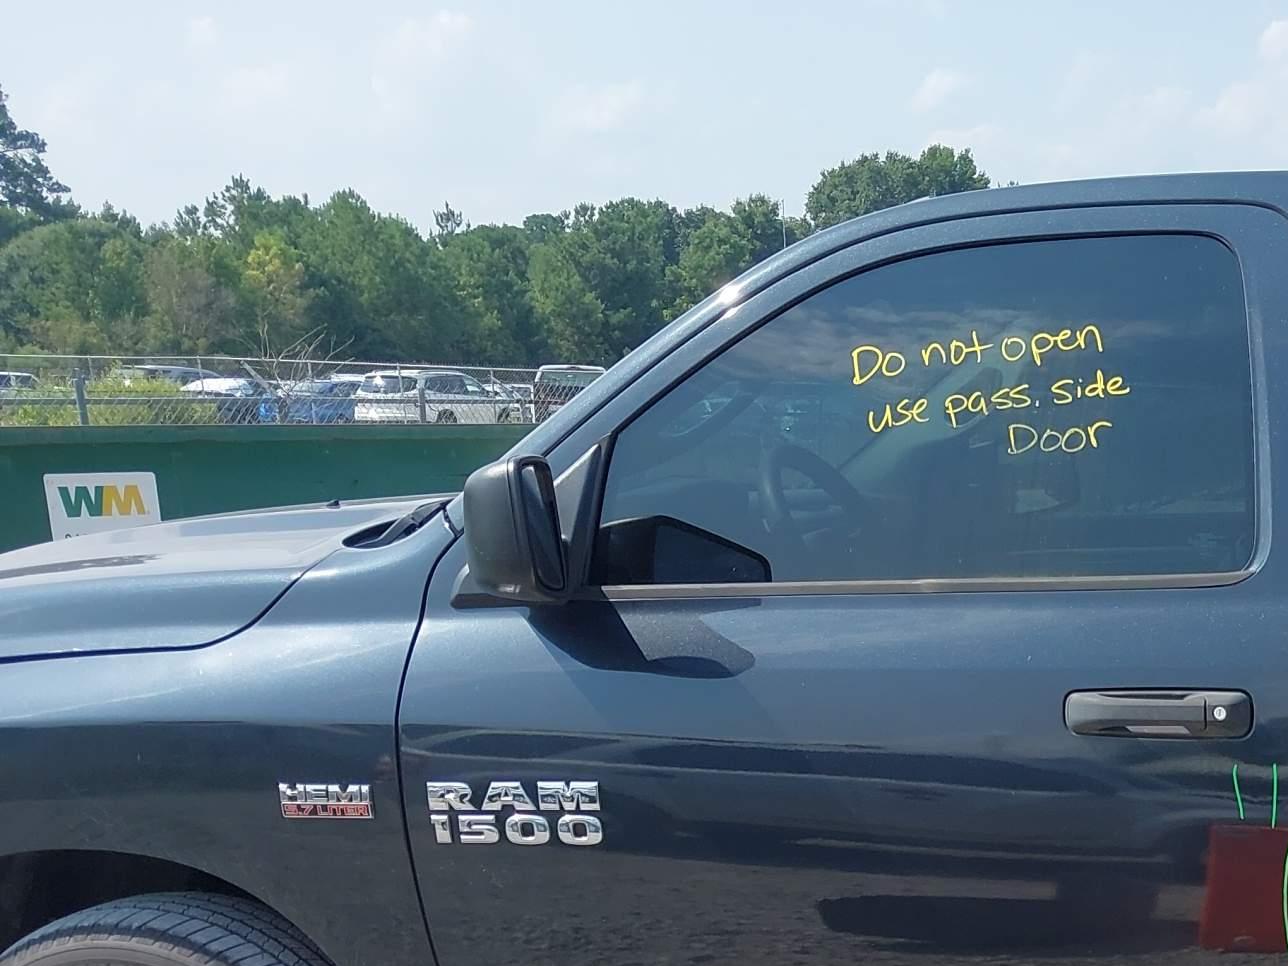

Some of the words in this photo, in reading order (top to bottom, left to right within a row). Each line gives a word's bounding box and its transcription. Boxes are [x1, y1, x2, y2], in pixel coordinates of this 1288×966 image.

[851, 345, 905, 385] Do
[921, 330, 994, 365] not
[1001, 324, 1104, 366] open
[868, 395, 930, 433] use
[944, 383, 1040, 428] pass.
[1051, 369, 1131, 405] side
[1007, 420, 1113, 455] Door
[57, 484, 146, 518] WM
[279, 782, 371, 803] HEMI
[426, 780, 601, 811] RAM
[284, 803, 312, 817] 5.7
[317, 803, 371, 817] LITER
[430, 813, 604, 846] 1500
